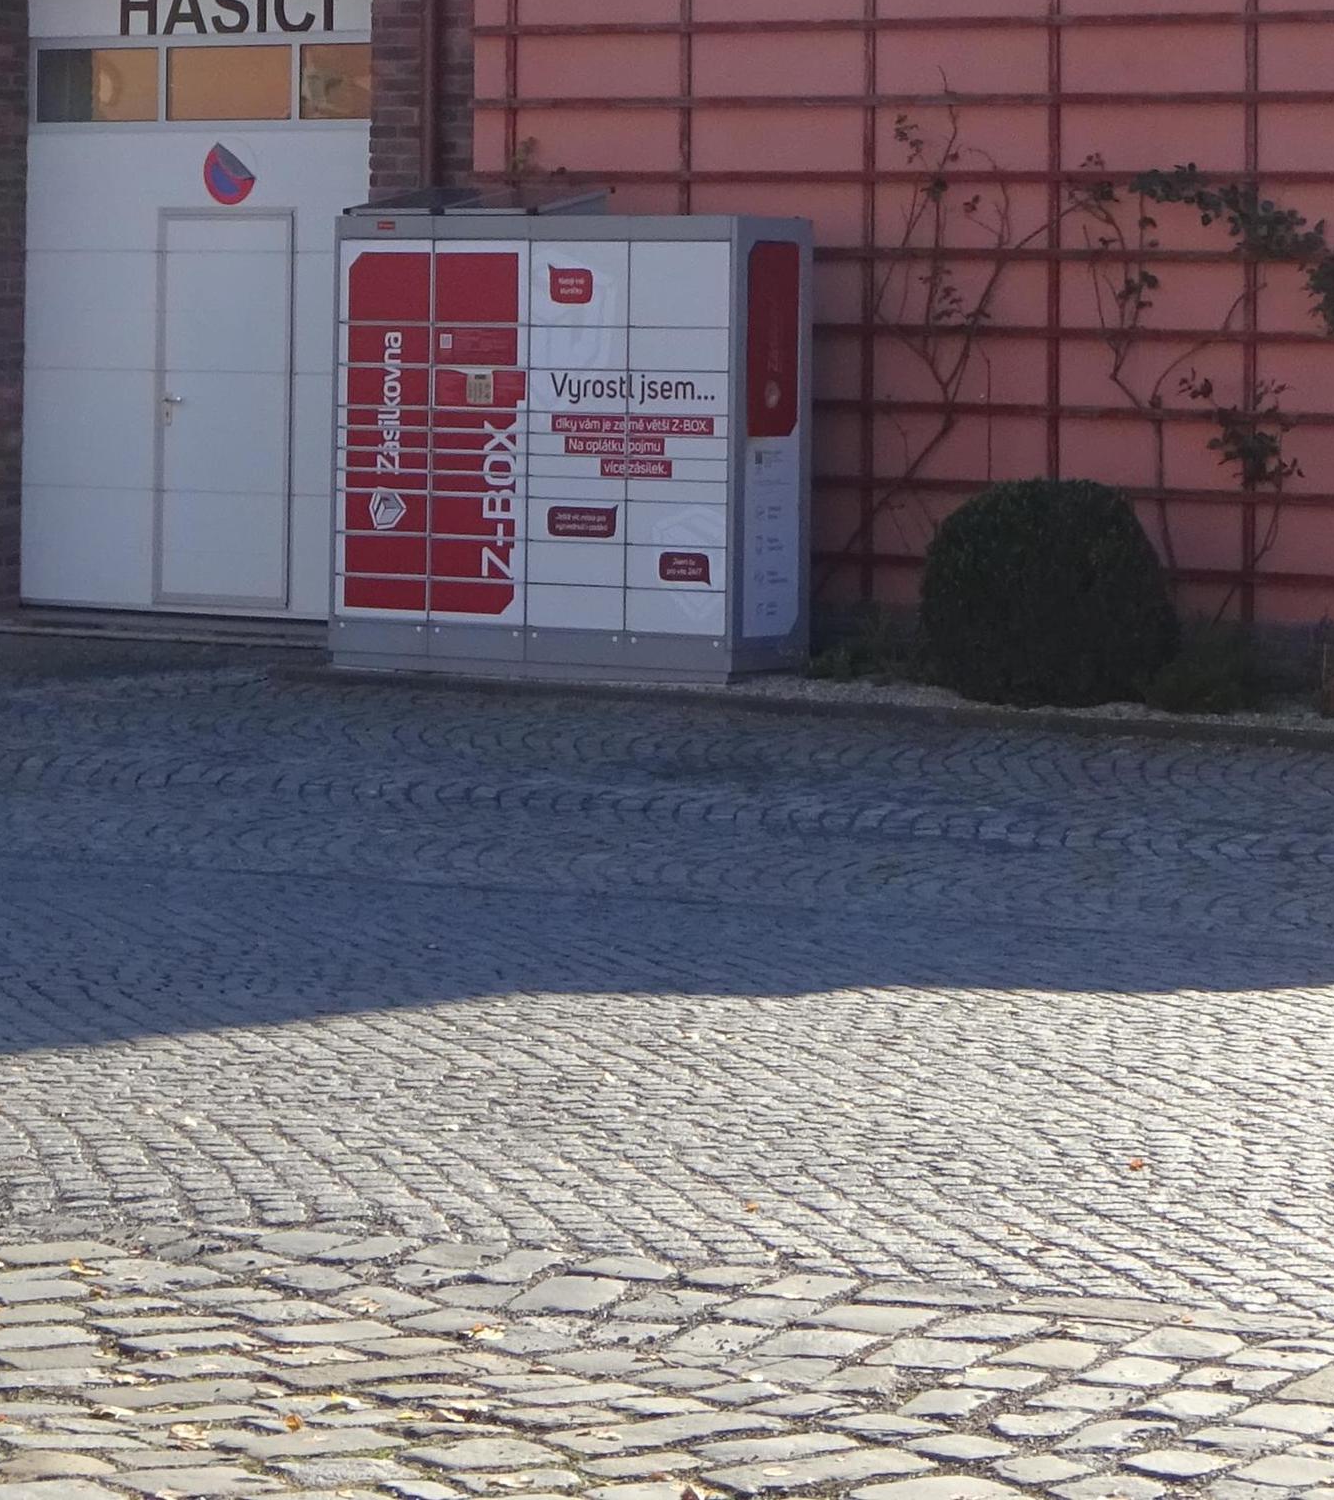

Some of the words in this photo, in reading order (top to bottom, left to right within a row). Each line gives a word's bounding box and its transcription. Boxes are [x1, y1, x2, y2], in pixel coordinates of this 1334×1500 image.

[550, 372, 635, 405] Vyrostl
[639, 374, 716, 405] jsem...
[376, 331, 403, 475] Zásilkovna
[579, 417, 601, 431] vám
[568, 438, 586, 451] Na
[586, 438, 625, 453] oplátku
[628, 440, 661, 454] pojmu
[603, 459, 626, 473] více
[482, 419, 518, 579] Z-BOX
